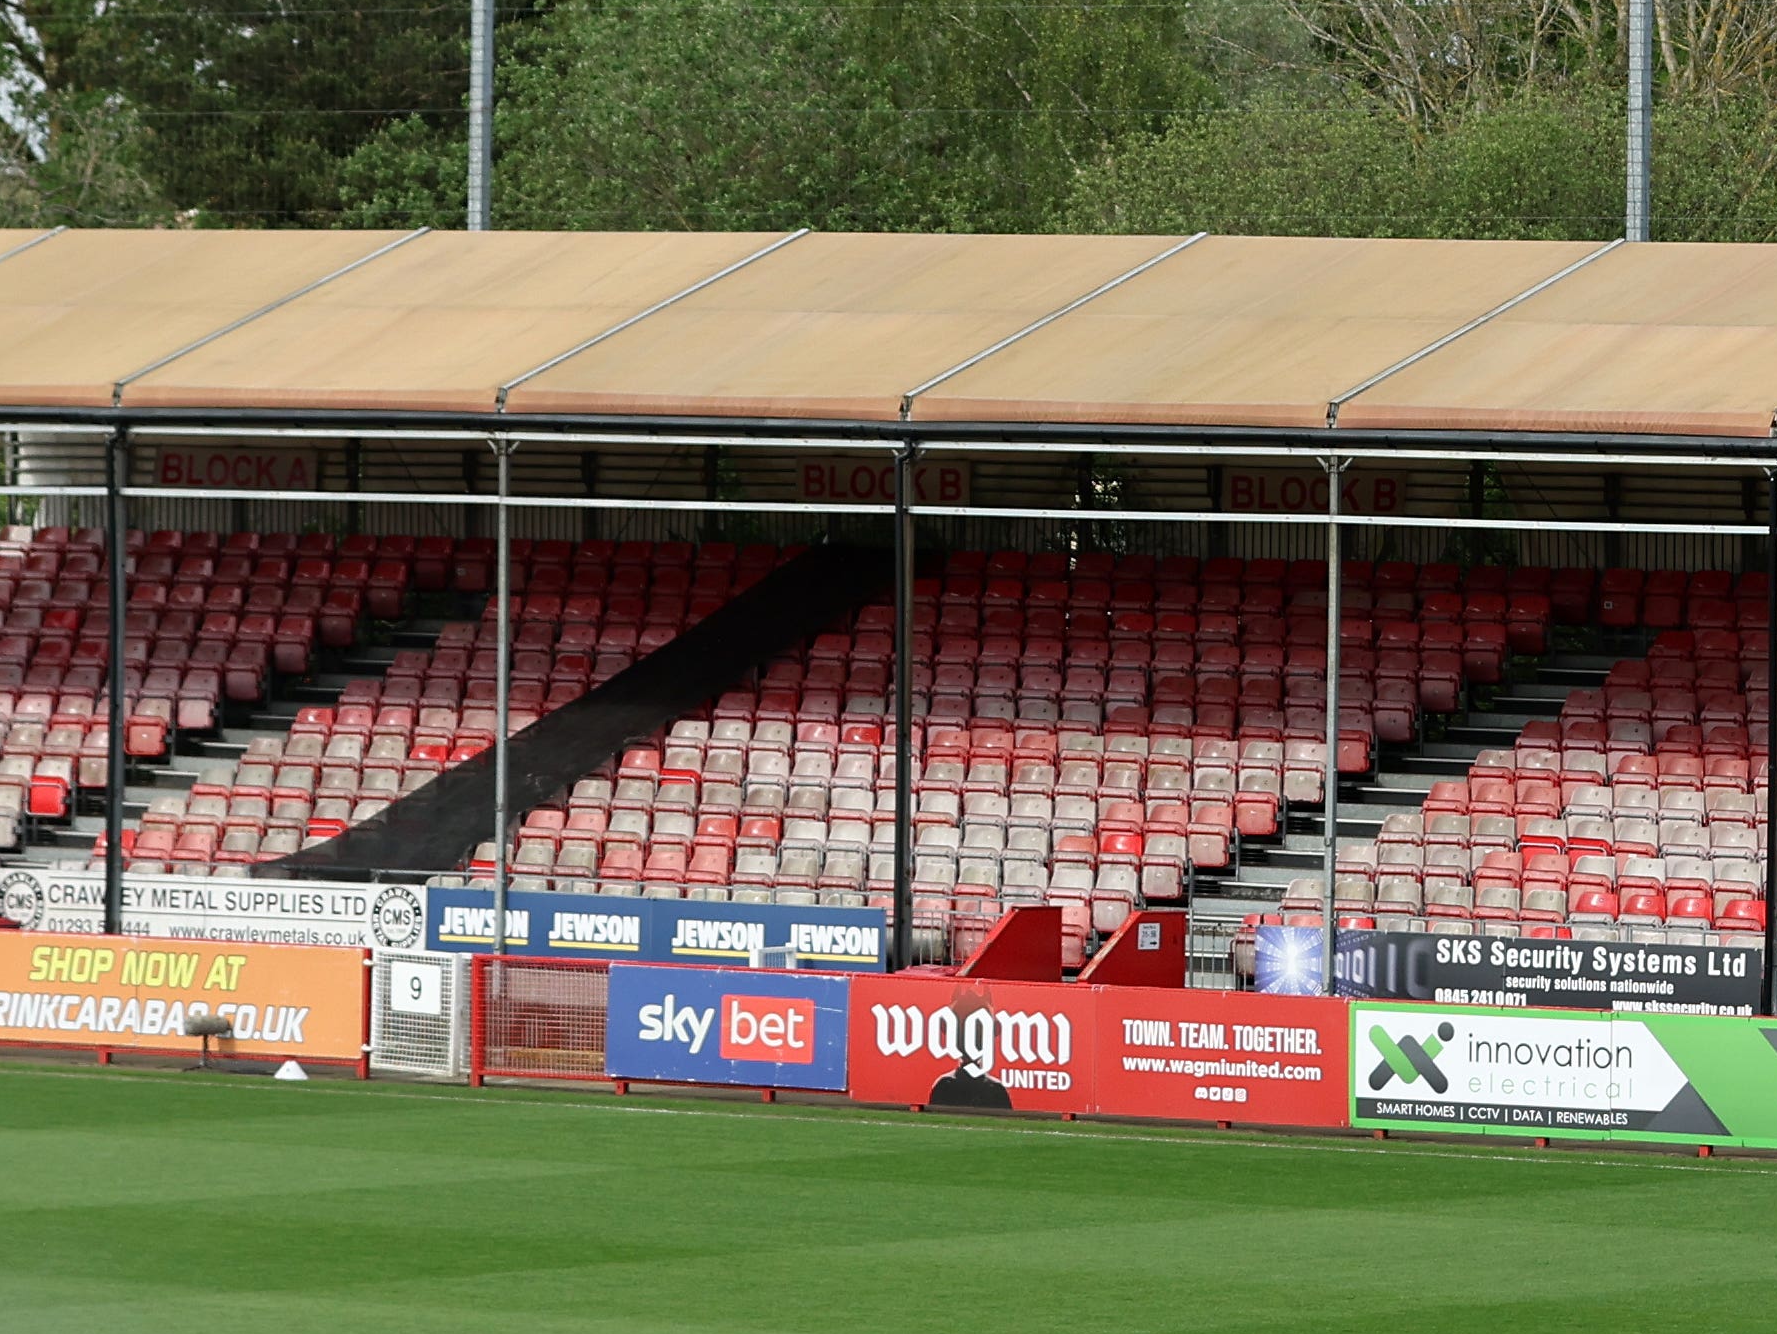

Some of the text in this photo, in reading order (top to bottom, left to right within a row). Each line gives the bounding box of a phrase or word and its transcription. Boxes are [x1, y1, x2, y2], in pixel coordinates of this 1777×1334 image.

[161, 452, 310, 489] BLOCK A
[939, 467, 962, 502] B
[1231, 475, 1397, 512] BLOCK B
[7, 893, 34, 909] CMS
[48, 884, 367, 917] CRAWEY METAL SUPPLIES LTD
[48, 918, 150, 935] 01293 5444
[382, 908, 411, 926] CMS
[548, 912, 640, 944] JEWSON
[169, 924, 366, 947] www.crawleymetals.co.uk
[672, 919, 765, 950] JEWSON
[785, 923, 880, 956] JEWSON
[28, 945, 248, 992] SHOP NOW AT
[1435, 938, 1747, 978] SKS Security Systems Ltd
[410, 975, 423, 1001] 9
[1434, 987, 1527, 1007] 0845 241 0071
[1505, 974, 1675, 995] security solutions nationwide
[1612, 999, 1753, 1016] www.skssecurity.co.uk
[638, 993, 806, 1055] sky bet
[1122, 1018, 1322, 1055] TOWN. TEAM. TOGETHER.
[870, 1003, 1073, 1079] wagmi
[1468, 1032, 1633, 1069] innovation
[1000, 1068, 1072, 1091] UNITED
[1122, 1055, 1322, 1081] www.wagmiunited.com
[1468, 1072, 1633, 1100] electrical
[1376, 1101, 1628, 1126] SMART HOMES CCTV DATA RENEWABLES
